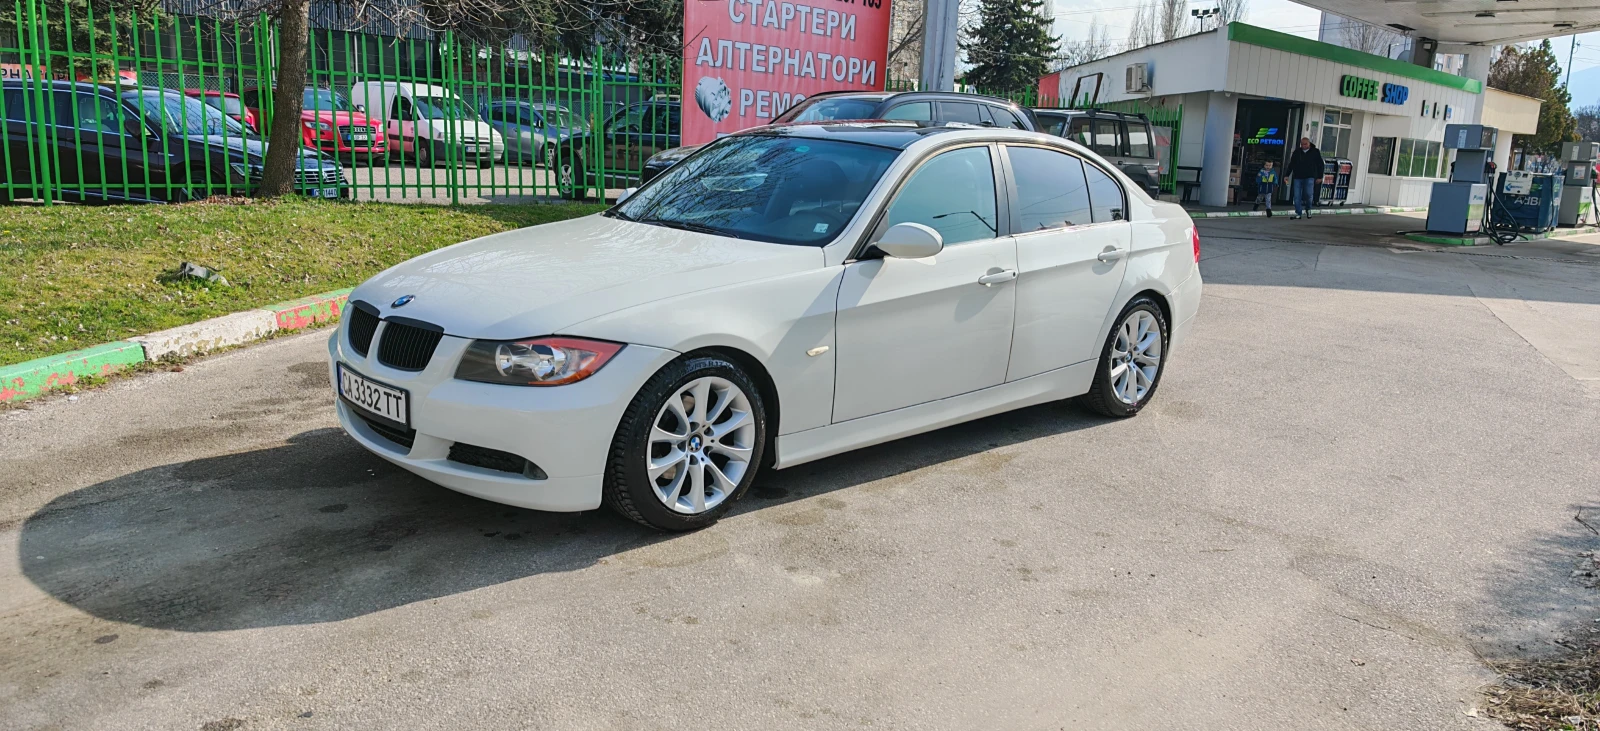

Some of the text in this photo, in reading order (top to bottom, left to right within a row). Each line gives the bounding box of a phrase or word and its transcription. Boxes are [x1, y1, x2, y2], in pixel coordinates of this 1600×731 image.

[729, 0, 856, 40] СТАРТЕРИ
[696, 37, 876, 86] АЛТЕРНАТОРИ
[1341, 75, 1409, 105] COFFEE SHOP
[342, 371, 402, 418] CA 3332 TT
